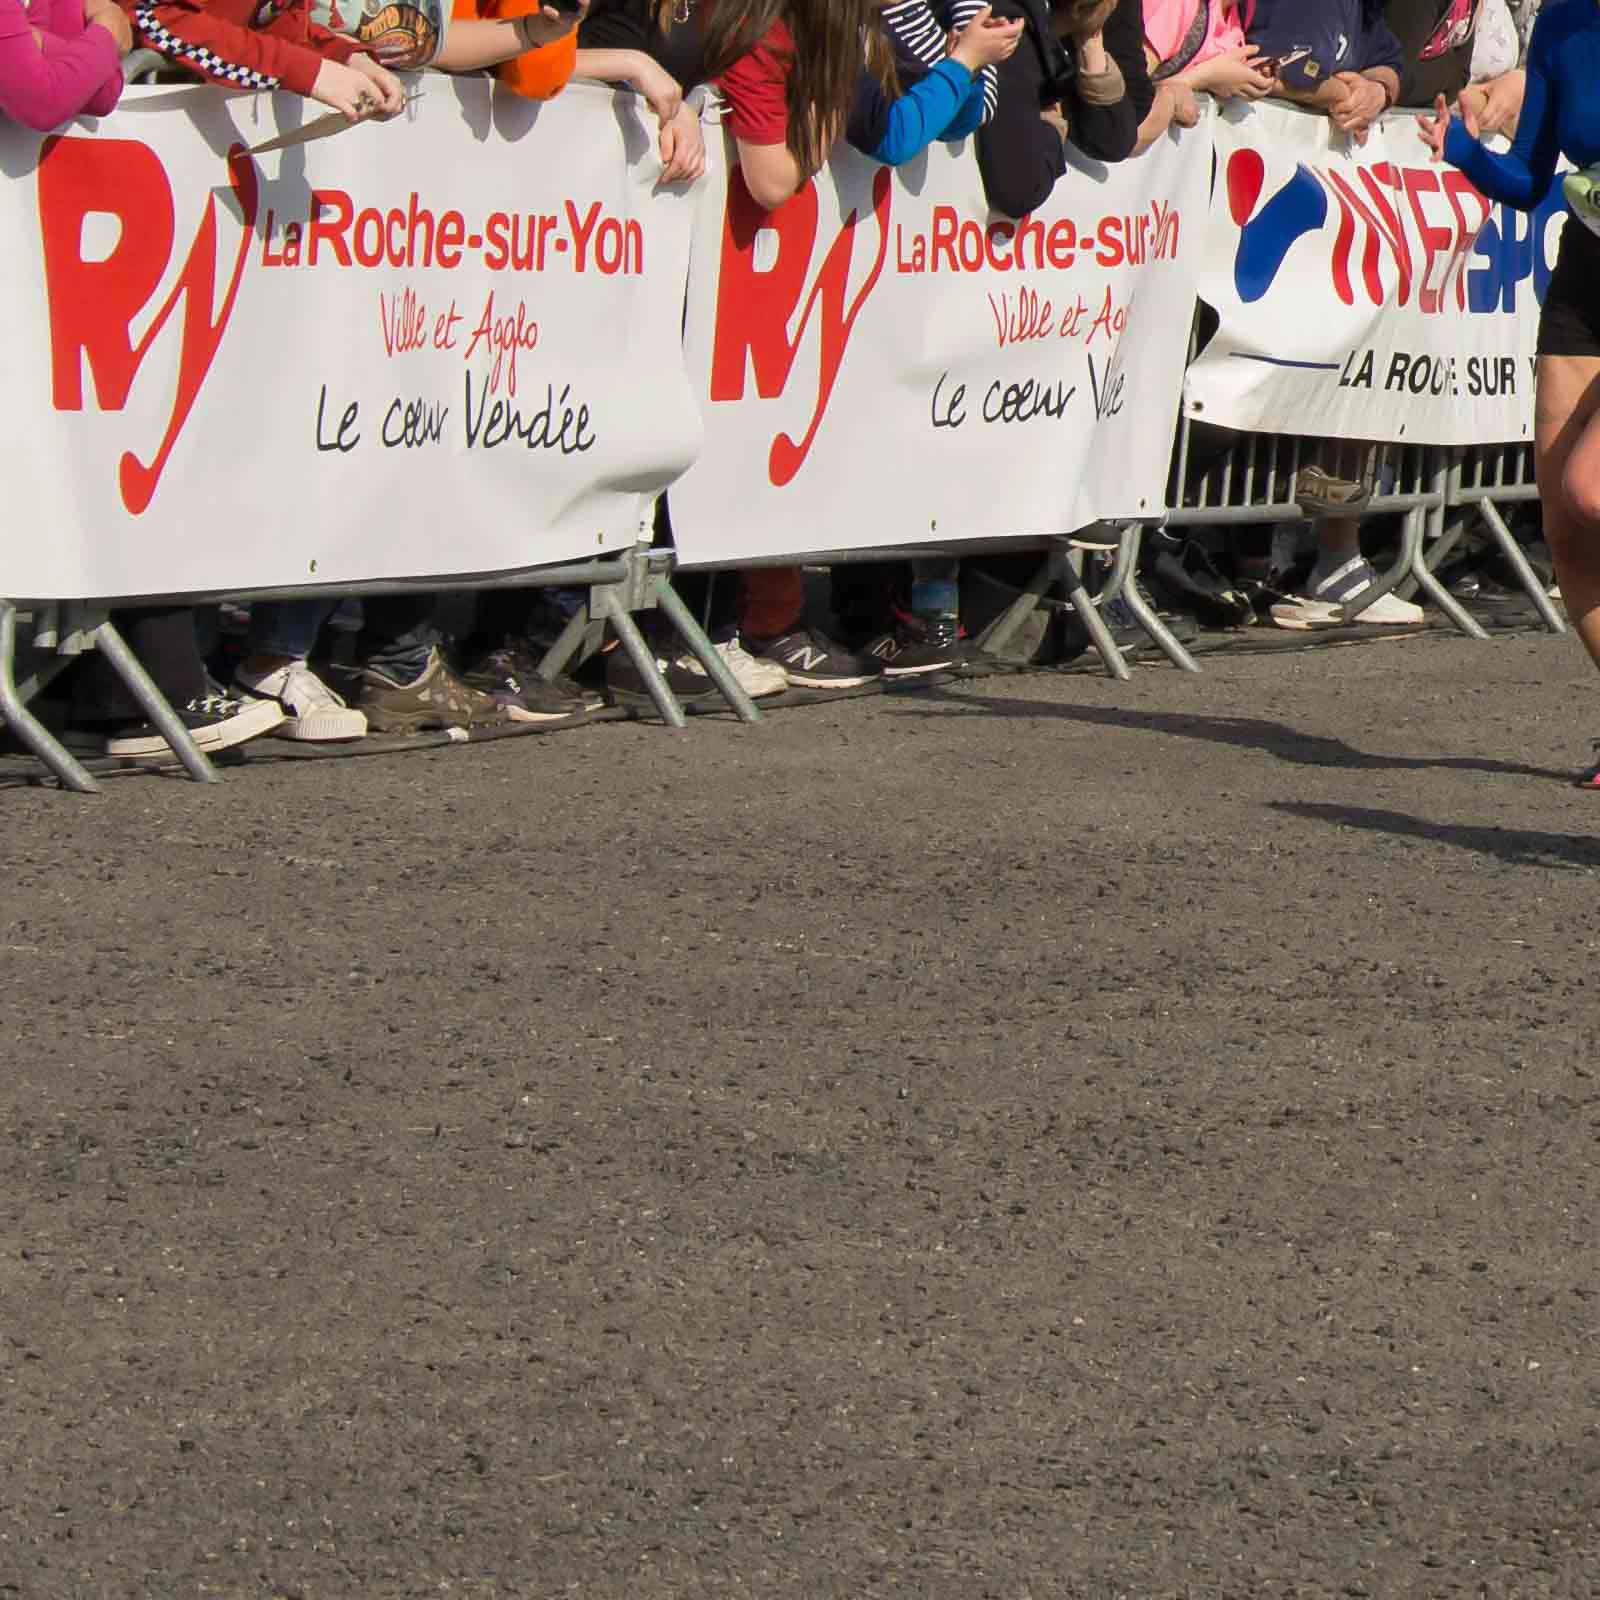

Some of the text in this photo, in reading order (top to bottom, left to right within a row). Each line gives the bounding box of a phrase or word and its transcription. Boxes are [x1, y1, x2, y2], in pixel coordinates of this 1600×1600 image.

[260, 188, 644, 276] La Roche-sur-Yon
[896, 199, 1180, 274] La Roche-sur-Yn
[379, 286, 541, 398] Ville et Agglo
[986, 284, 1054, 349] Ville
[1060, 294, 1089, 338] et
[931, 368, 967, 429] Le
[1338, 349, 1374, 388] LA
[1466, 355, 1517, 396] SUR
[315, 383, 362, 454] Le
[464, 368, 597, 455] Vendée
